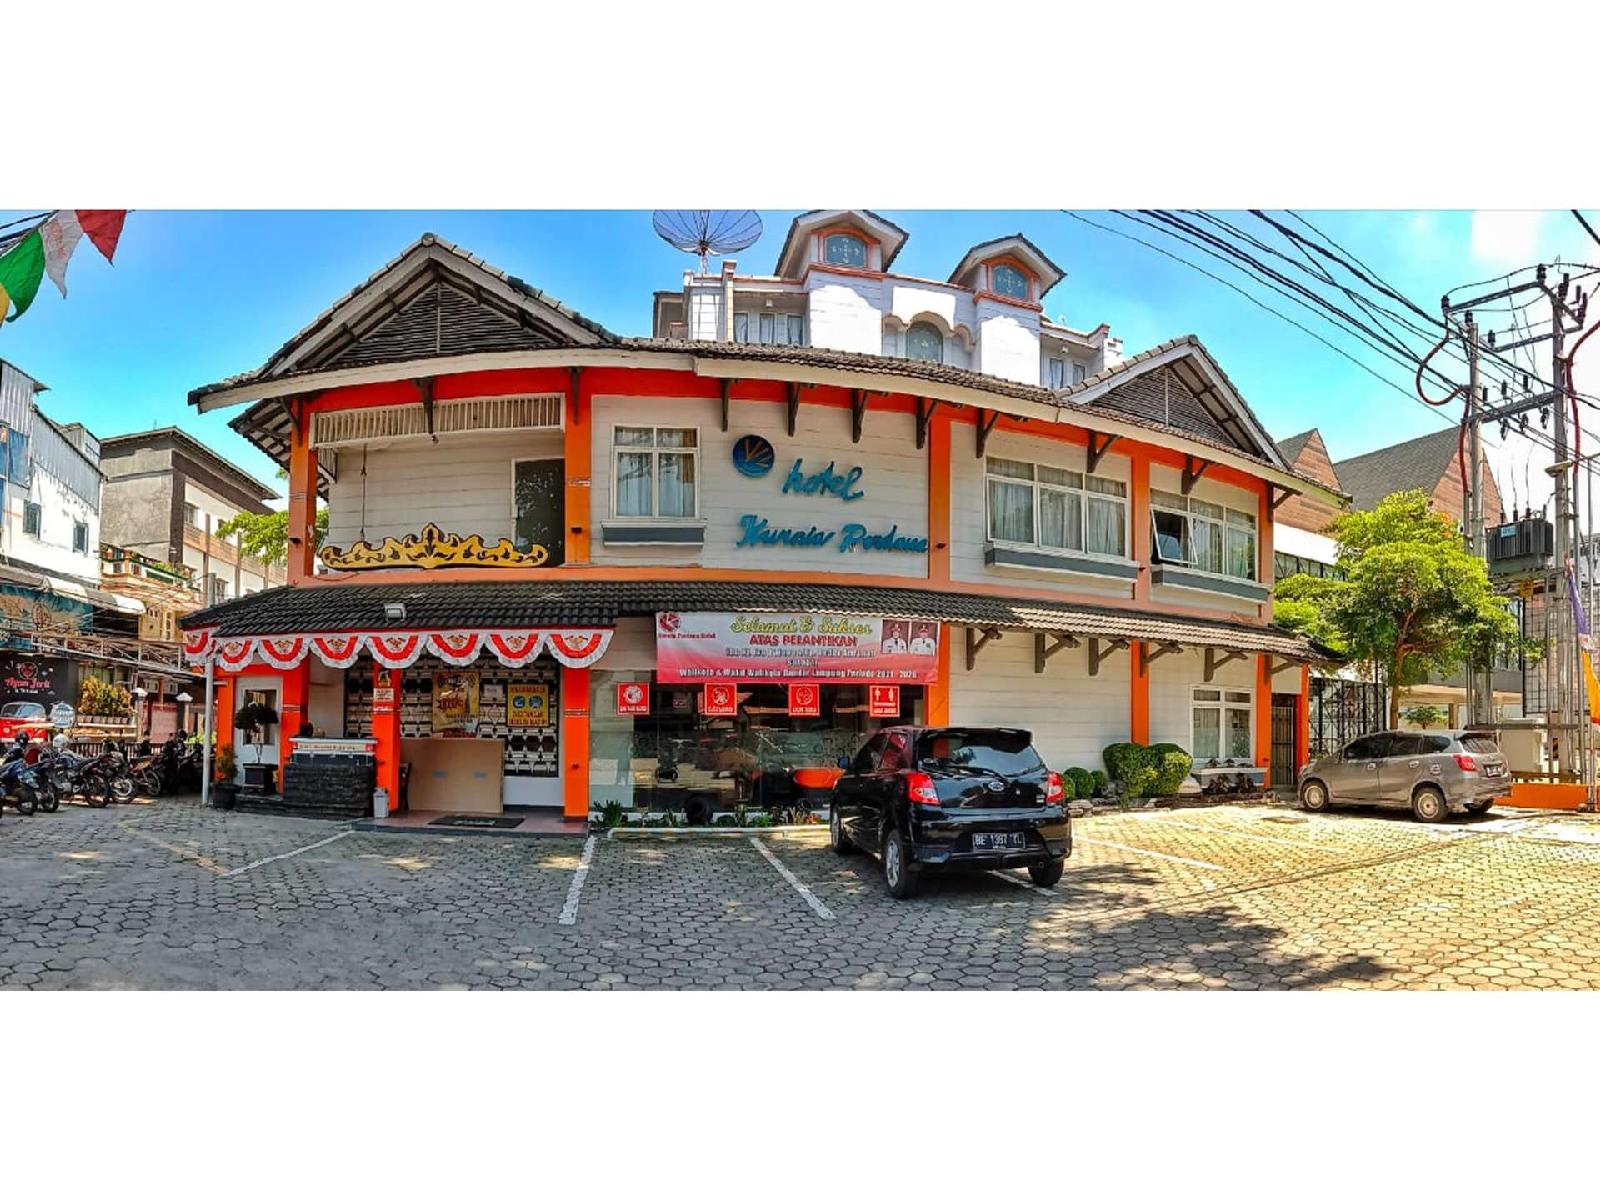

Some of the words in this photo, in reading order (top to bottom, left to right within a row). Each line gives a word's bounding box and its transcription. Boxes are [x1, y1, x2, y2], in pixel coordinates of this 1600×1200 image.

[782, 457, 864, 502] hotel
[730, 615, 797, 634] Selamat
[749, 635, 779, 646] ATAS
[782, 635, 857, 647] PELANTIKAN
